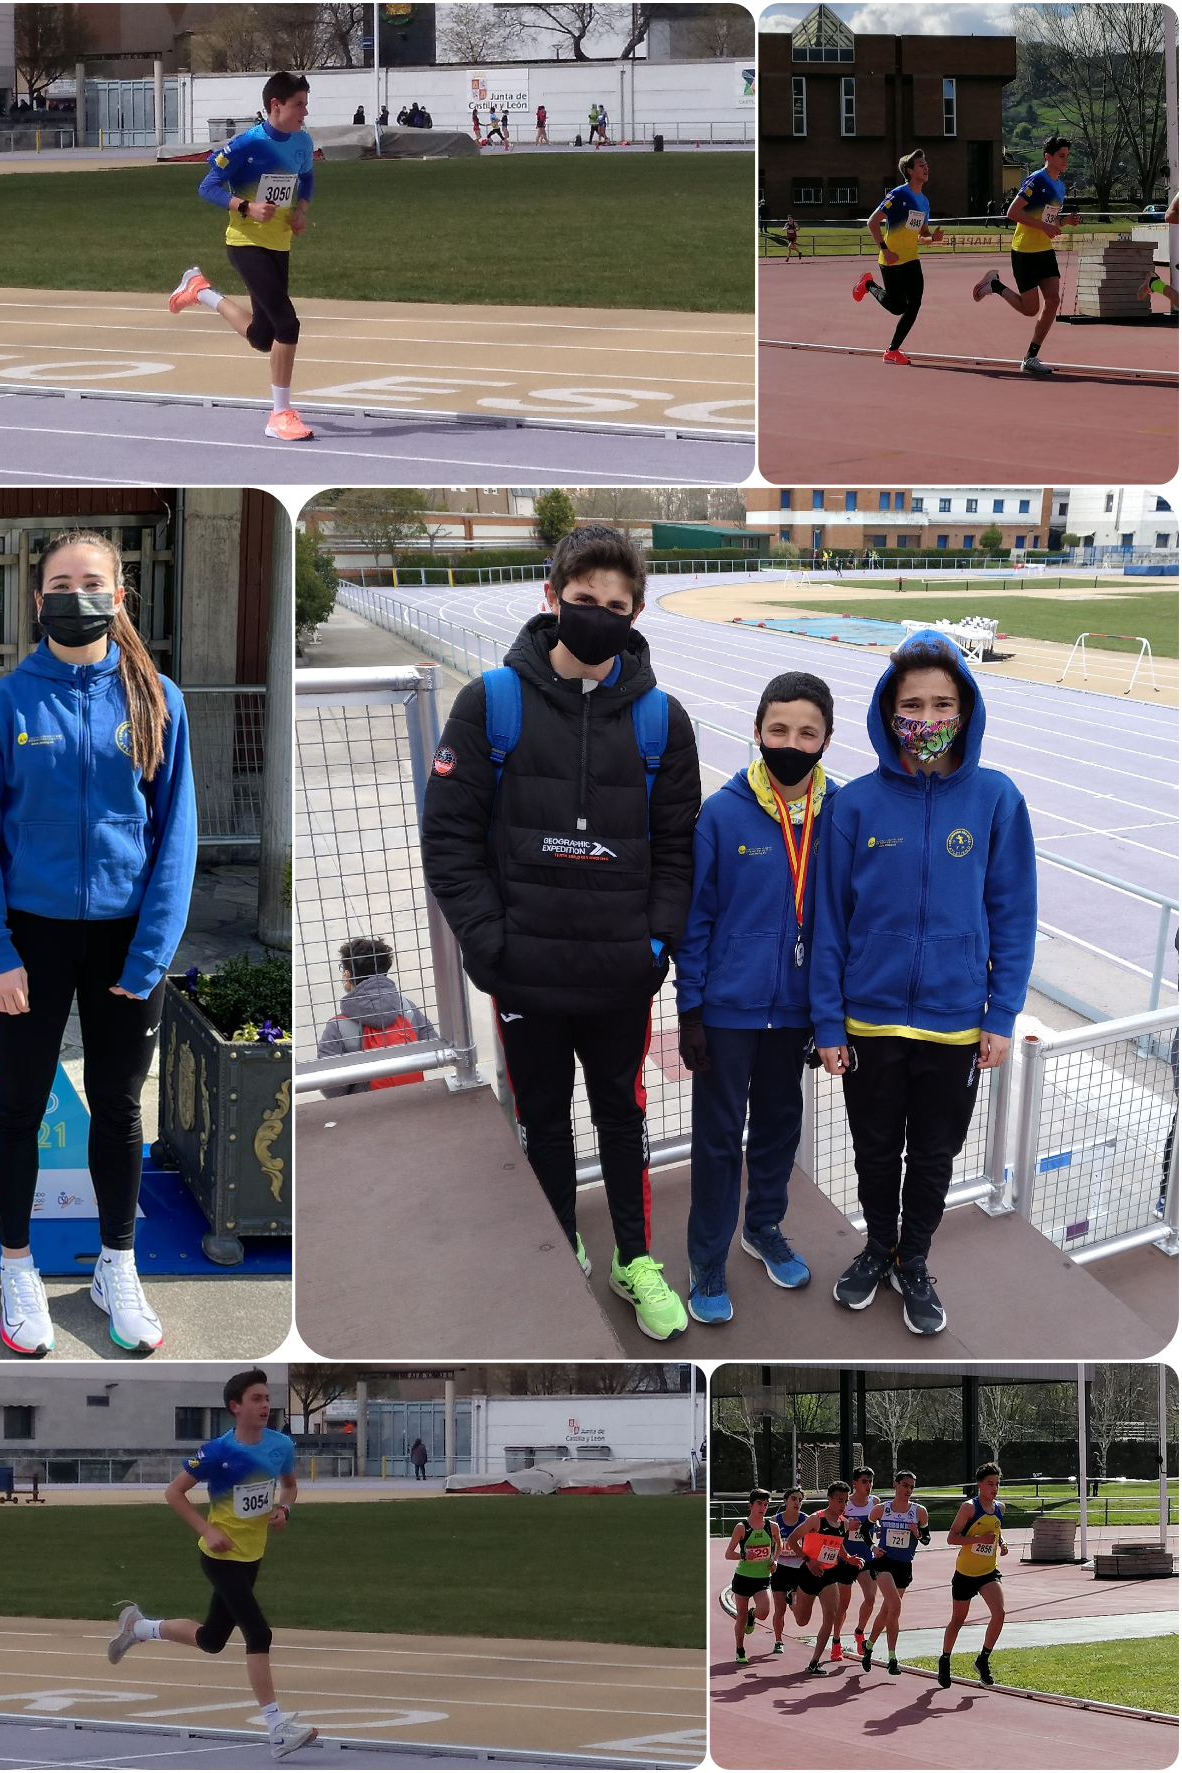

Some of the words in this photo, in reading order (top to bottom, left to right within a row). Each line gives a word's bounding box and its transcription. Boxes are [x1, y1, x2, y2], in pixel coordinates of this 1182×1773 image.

[490, 93, 514, 102] Junta
[515, 92, 527, 101] de
[506, 101, 527, 110] León
[265, 186, 291, 201] 3050
[543, 837, 591, 849] GEOGRAPHIC
[542, 844, 586, 855] EXPEDITION
[242, 1491, 269, 1512] 3054
[892, 1536, 904, 1546] 721
